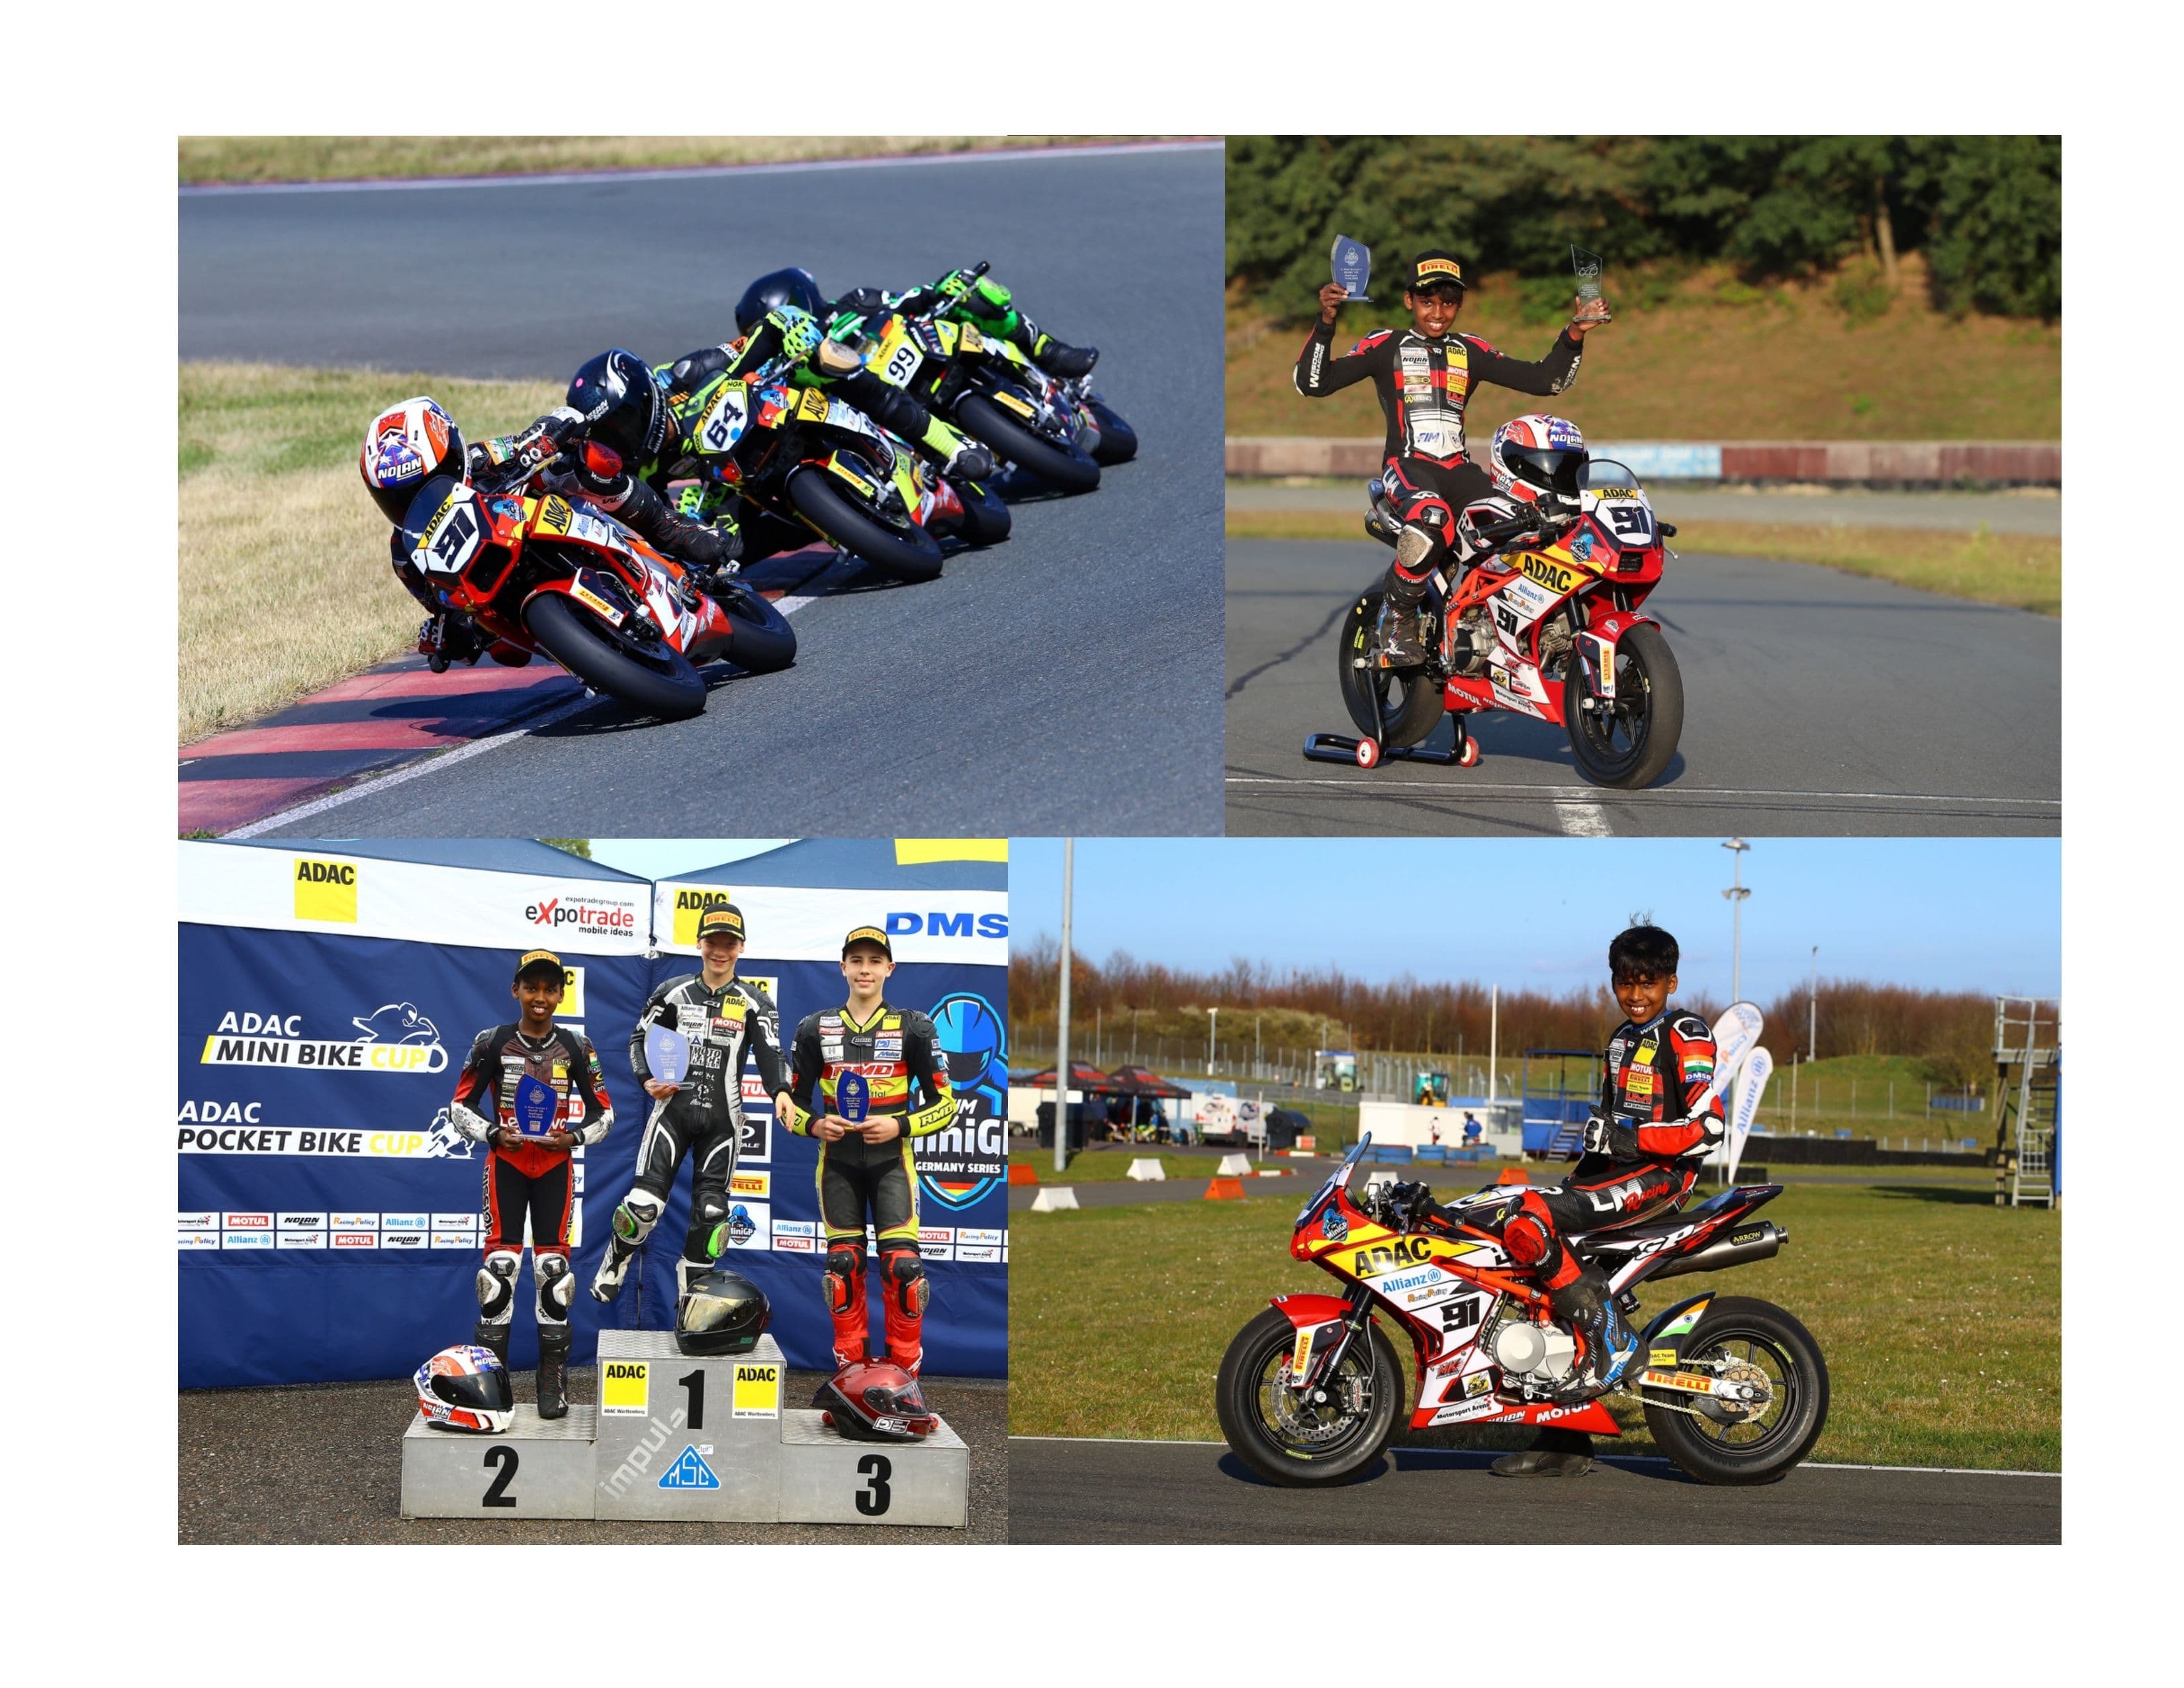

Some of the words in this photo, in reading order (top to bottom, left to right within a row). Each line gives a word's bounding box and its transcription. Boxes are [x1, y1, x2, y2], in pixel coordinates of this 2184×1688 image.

[1420, 262, 1459, 276] PIRELLI
[1316, 345, 1325, 376] RACING
[1447, 347, 1467, 356] ADAC
[888, 347, 916, 381] 99
[1309, 342, 1322, 389] WISDOM
[1447, 367, 1469, 377] MOTUL
[728, 380, 743, 389] NGK
[701, 390, 723, 424] ADAC
[706, 401, 744, 448] 64
[1416, 432, 1439, 443] FIM
[1549, 434, 1583, 448] NOLAN
[378, 457, 422, 481] NOLAN
[1603, 488, 1634, 498] ADAC
[424, 500, 451, 541] ADAC
[1606, 506, 1651, 536] 91
[432, 506, 477, 571] 91
[1523, 554, 1572, 592] ADAC
[1518, 583, 1538, 601] Allianz
[1496, 604, 1519, 637] 91
[1447, 682, 1482, 706] MOTUL
[296, 861, 355, 886] ADAC
[565, 896, 635, 908] expotradegroup.com
[676, 891, 728, 910] ADAC
[706, 913, 740, 927] PIRELLI
[886, 912, 1009, 939] DMS
[578, 925, 608, 935] mobile
[610, 926, 634, 937] ideas
[725, 996, 747, 1008] ADAC
[216, 1011, 302, 1037] ADAC
[714, 1018, 744, 1029] MOTUL
[216, 1039, 289, 1064] MINI
[297, 1044, 364, 1067] BIKE
[370, 1047, 427, 1069] CUP
[1641, 1039, 1659, 1051] ADAC
[553, 1059, 571, 1068] ADAC
[1630, 1062, 1654, 1074] MOTUL
[1685, 1071, 1712, 1080] DMSB
[177, 1100, 262, 1124] ADAC
[1736, 1079, 1759, 1135] Allianz
[498, 1111, 567, 1130] Levo
[177, 1128, 293, 1152] POCKET
[298, 1131, 363, 1153] BIKE
[369, 1133, 423, 1155] CUP
[915, 1161, 965, 1173] GERMANY
[968, 1162, 1001, 1174] SERIES
[1586, 1179, 1643, 1212] LM
[1624, 1180, 1670, 1214] Racing
[231, 1217, 267, 1225] MOTUL
[284, 1217, 320, 1227] NOLAN
[385, 1218, 414, 1227] Allianz
[776, 1224, 802, 1233] Allianz
[227, 1235, 258, 1244] Allianz
[918, 1231, 948, 1240] MOTUL
[1326, 1222, 1348, 1239] MiniGP
[1733, 1229, 1763, 1243] ARROW
[338, 1237, 372, 1245] MOTUL
[387, 1236, 421, 1245] NOLAN
[778, 1239, 809, 1248] MOTUL
[919, 1247, 947, 1256] NOLAN
[1355, 1237, 1432, 1277] ADAC
[1382, 1272, 1428, 1293] Allianz
[1439, 1295, 1480, 1334] 91
[1295, 1336, 1310, 1370] PIRELLI
[606, 1364, 646, 1380] ADAC
[737, 1368, 776, 1382] ADAC
[1647, 1371, 1712, 1391] PIRELLI
[678, 1369, 705, 1430] 1
[422, 1403, 450, 1416] NOLAN
[1436, 1407, 1471, 1420] Motorsport
[1471, 1403, 1490, 1413] Arena
[1535, 1399, 1592, 1424] MOTUL
[482, 1445, 520, 1507] 2
[668, 1450, 709, 1485] MSC
[855, 1454, 892, 1517] 3
